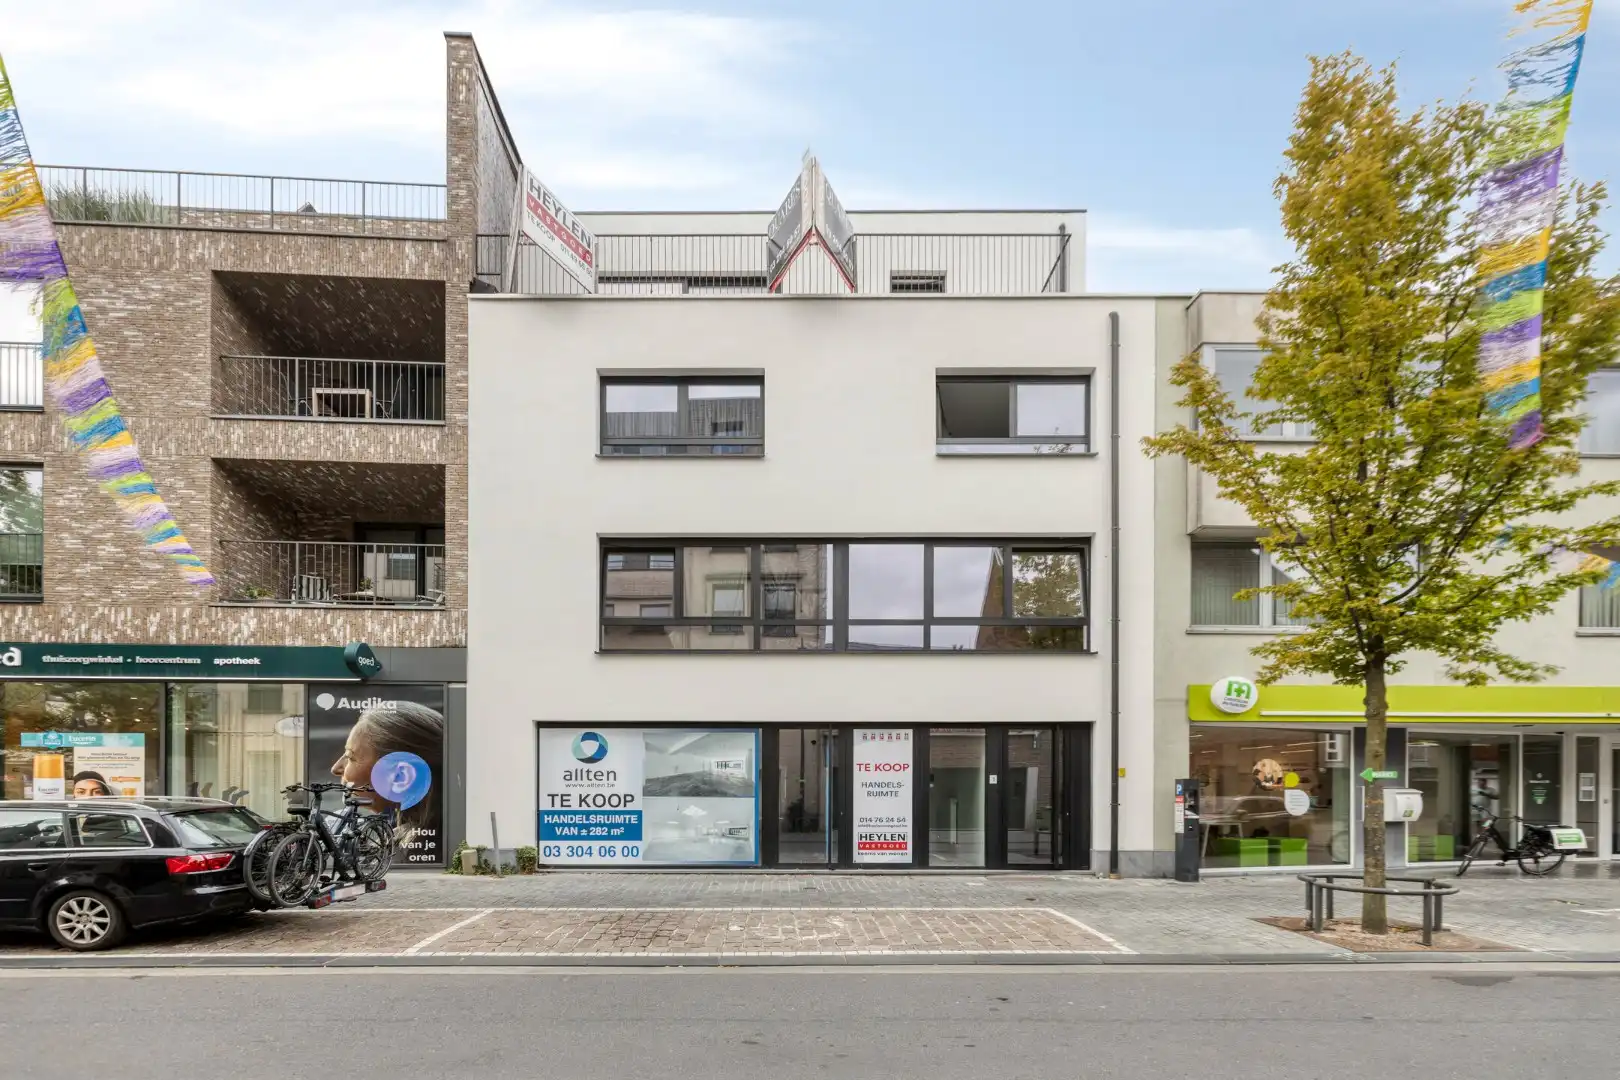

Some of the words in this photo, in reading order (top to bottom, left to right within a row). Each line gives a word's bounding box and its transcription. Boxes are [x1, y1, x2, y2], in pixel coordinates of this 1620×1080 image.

[530, 177, 591, 249] HEYLEN
[529, 198, 591, 261] VASTGOED
[42, 654, 123, 665] thuiszorgwinkel
[135, 656, 201, 664] hoorcentrum
[213, 657, 261, 666] apotheek
[358, 656, 375, 667] goed
[337, 697, 397, 710] Audika
[856, 763, 871, 772] TE
[874, 763, 910, 772] KOOP
[563, 768, 617, 782] allten
[861, 781, 905, 789] HANDELS-
[547, 793, 572, 808] TE
[578, 793, 635, 808] KOOP
[544, 814, 639, 824] HANDELSRUIMTE
[411, 827, 436, 836] Hou
[555, 826, 578, 836] VAN
[580, 828, 588, 836] ±
[589, 826, 609, 836] 282
[610, 826, 625, 836] m²
[859, 833, 906, 841] HEYLEN
[401, 841, 423, 849] van
[424, 839, 436, 851] je
[543, 845, 561, 858] 03
[566, 845, 593, 858] 304
[598, 845, 617, 858] 06
[621, 845, 640, 858] 00
[409, 854, 436, 862] oren
